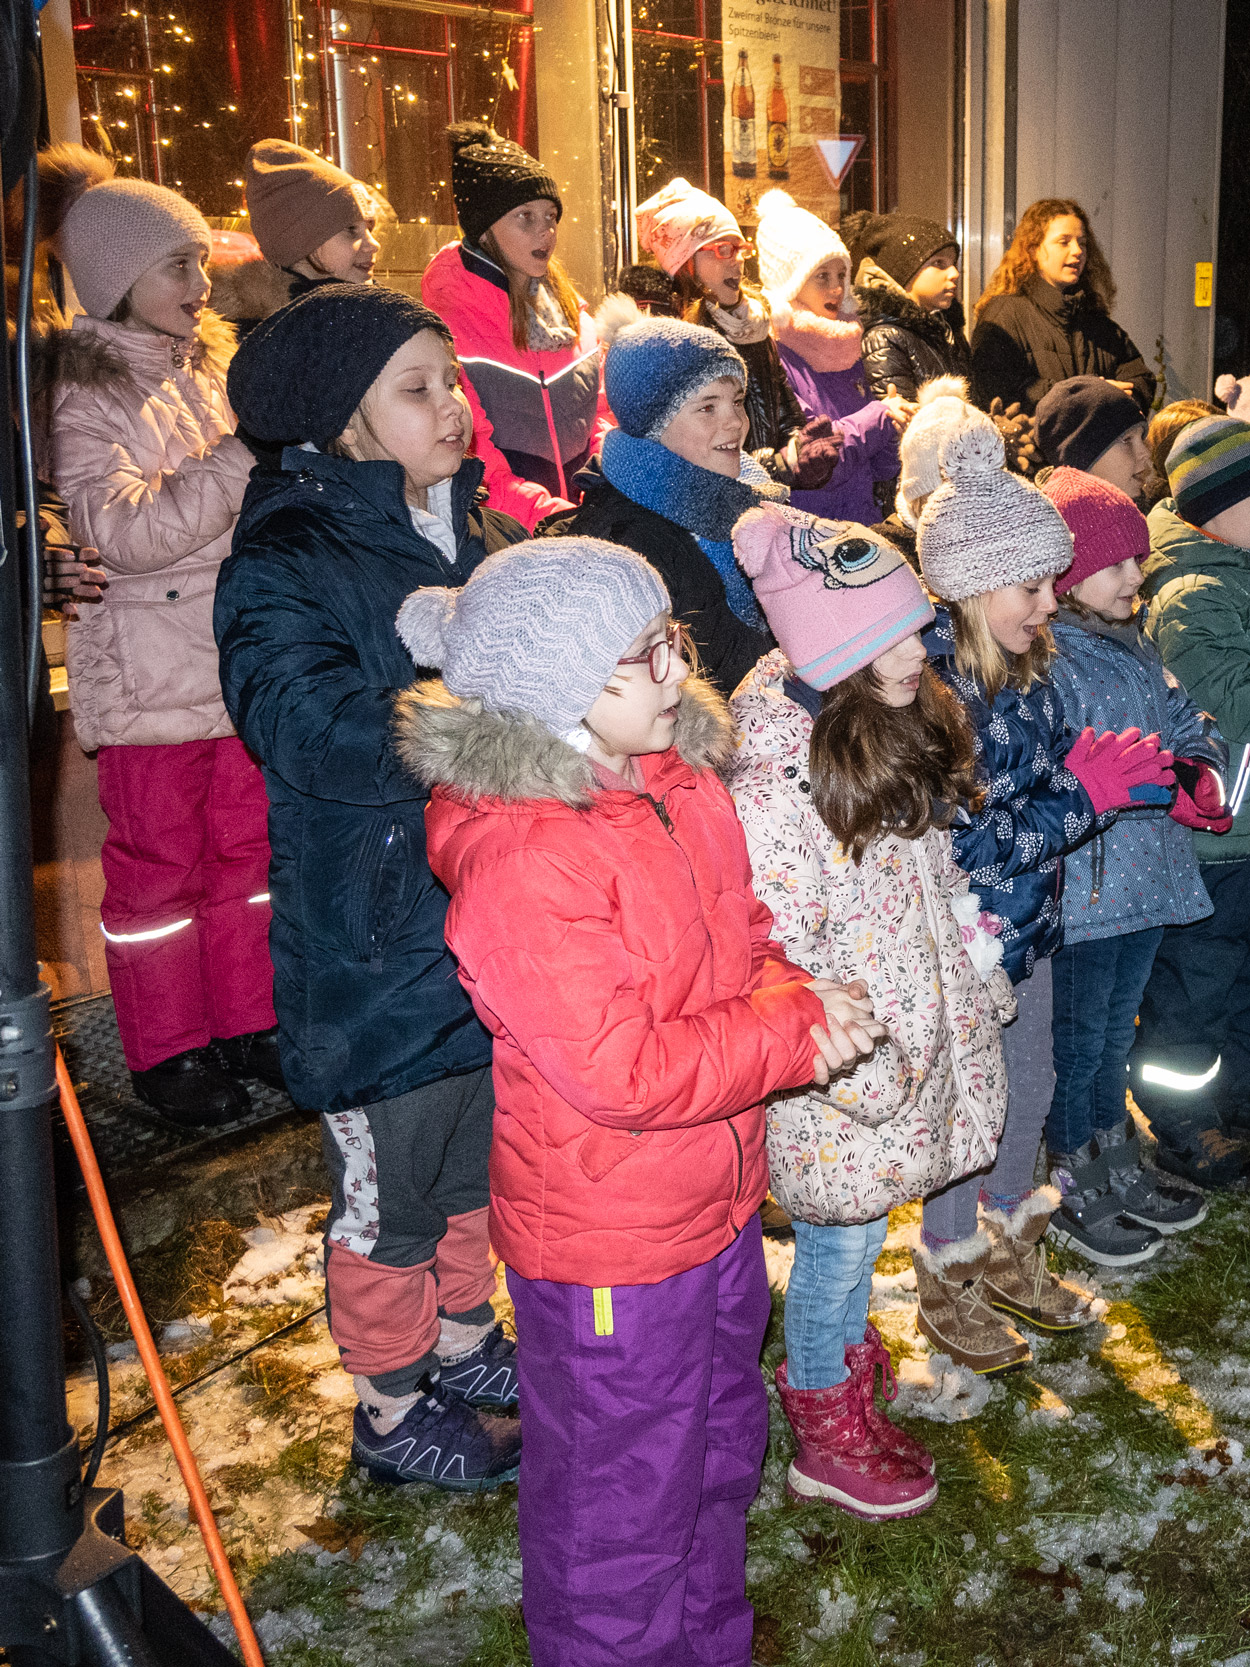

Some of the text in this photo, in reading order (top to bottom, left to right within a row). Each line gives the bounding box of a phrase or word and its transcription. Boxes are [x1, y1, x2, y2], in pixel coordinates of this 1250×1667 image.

[728, 7, 831, 34] Zweimal Bronze für unsere
[728, 23, 781, 41] Spitzenbiere!
